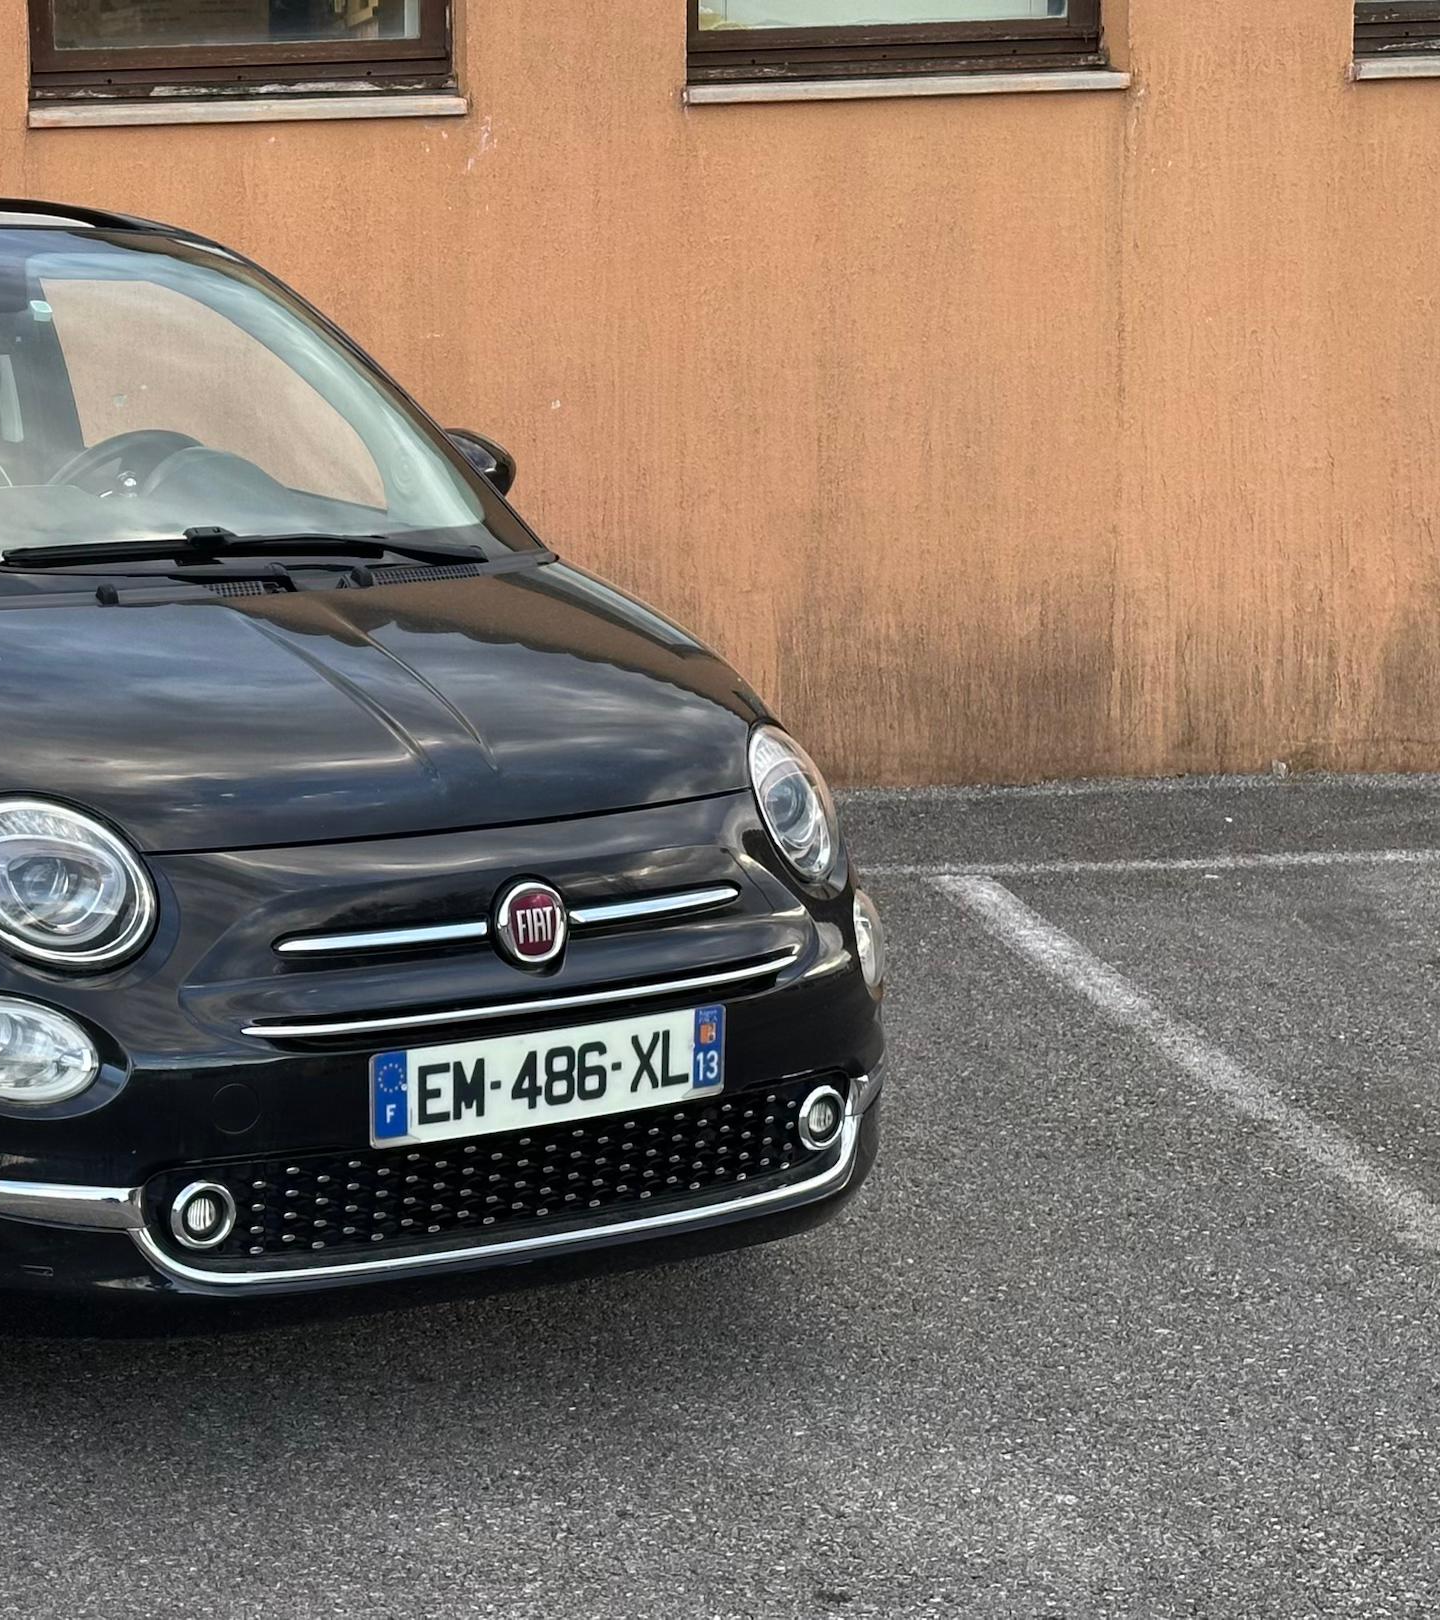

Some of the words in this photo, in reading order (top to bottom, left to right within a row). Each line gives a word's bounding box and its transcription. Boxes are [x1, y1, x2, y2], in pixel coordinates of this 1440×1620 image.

[516, 906, 553, 944] FIAT
[417, 1029, 689, 1125] EM-486-XL
[696, 1051, 719, 1080] 13
[385, 1104, 396, 1124] F
